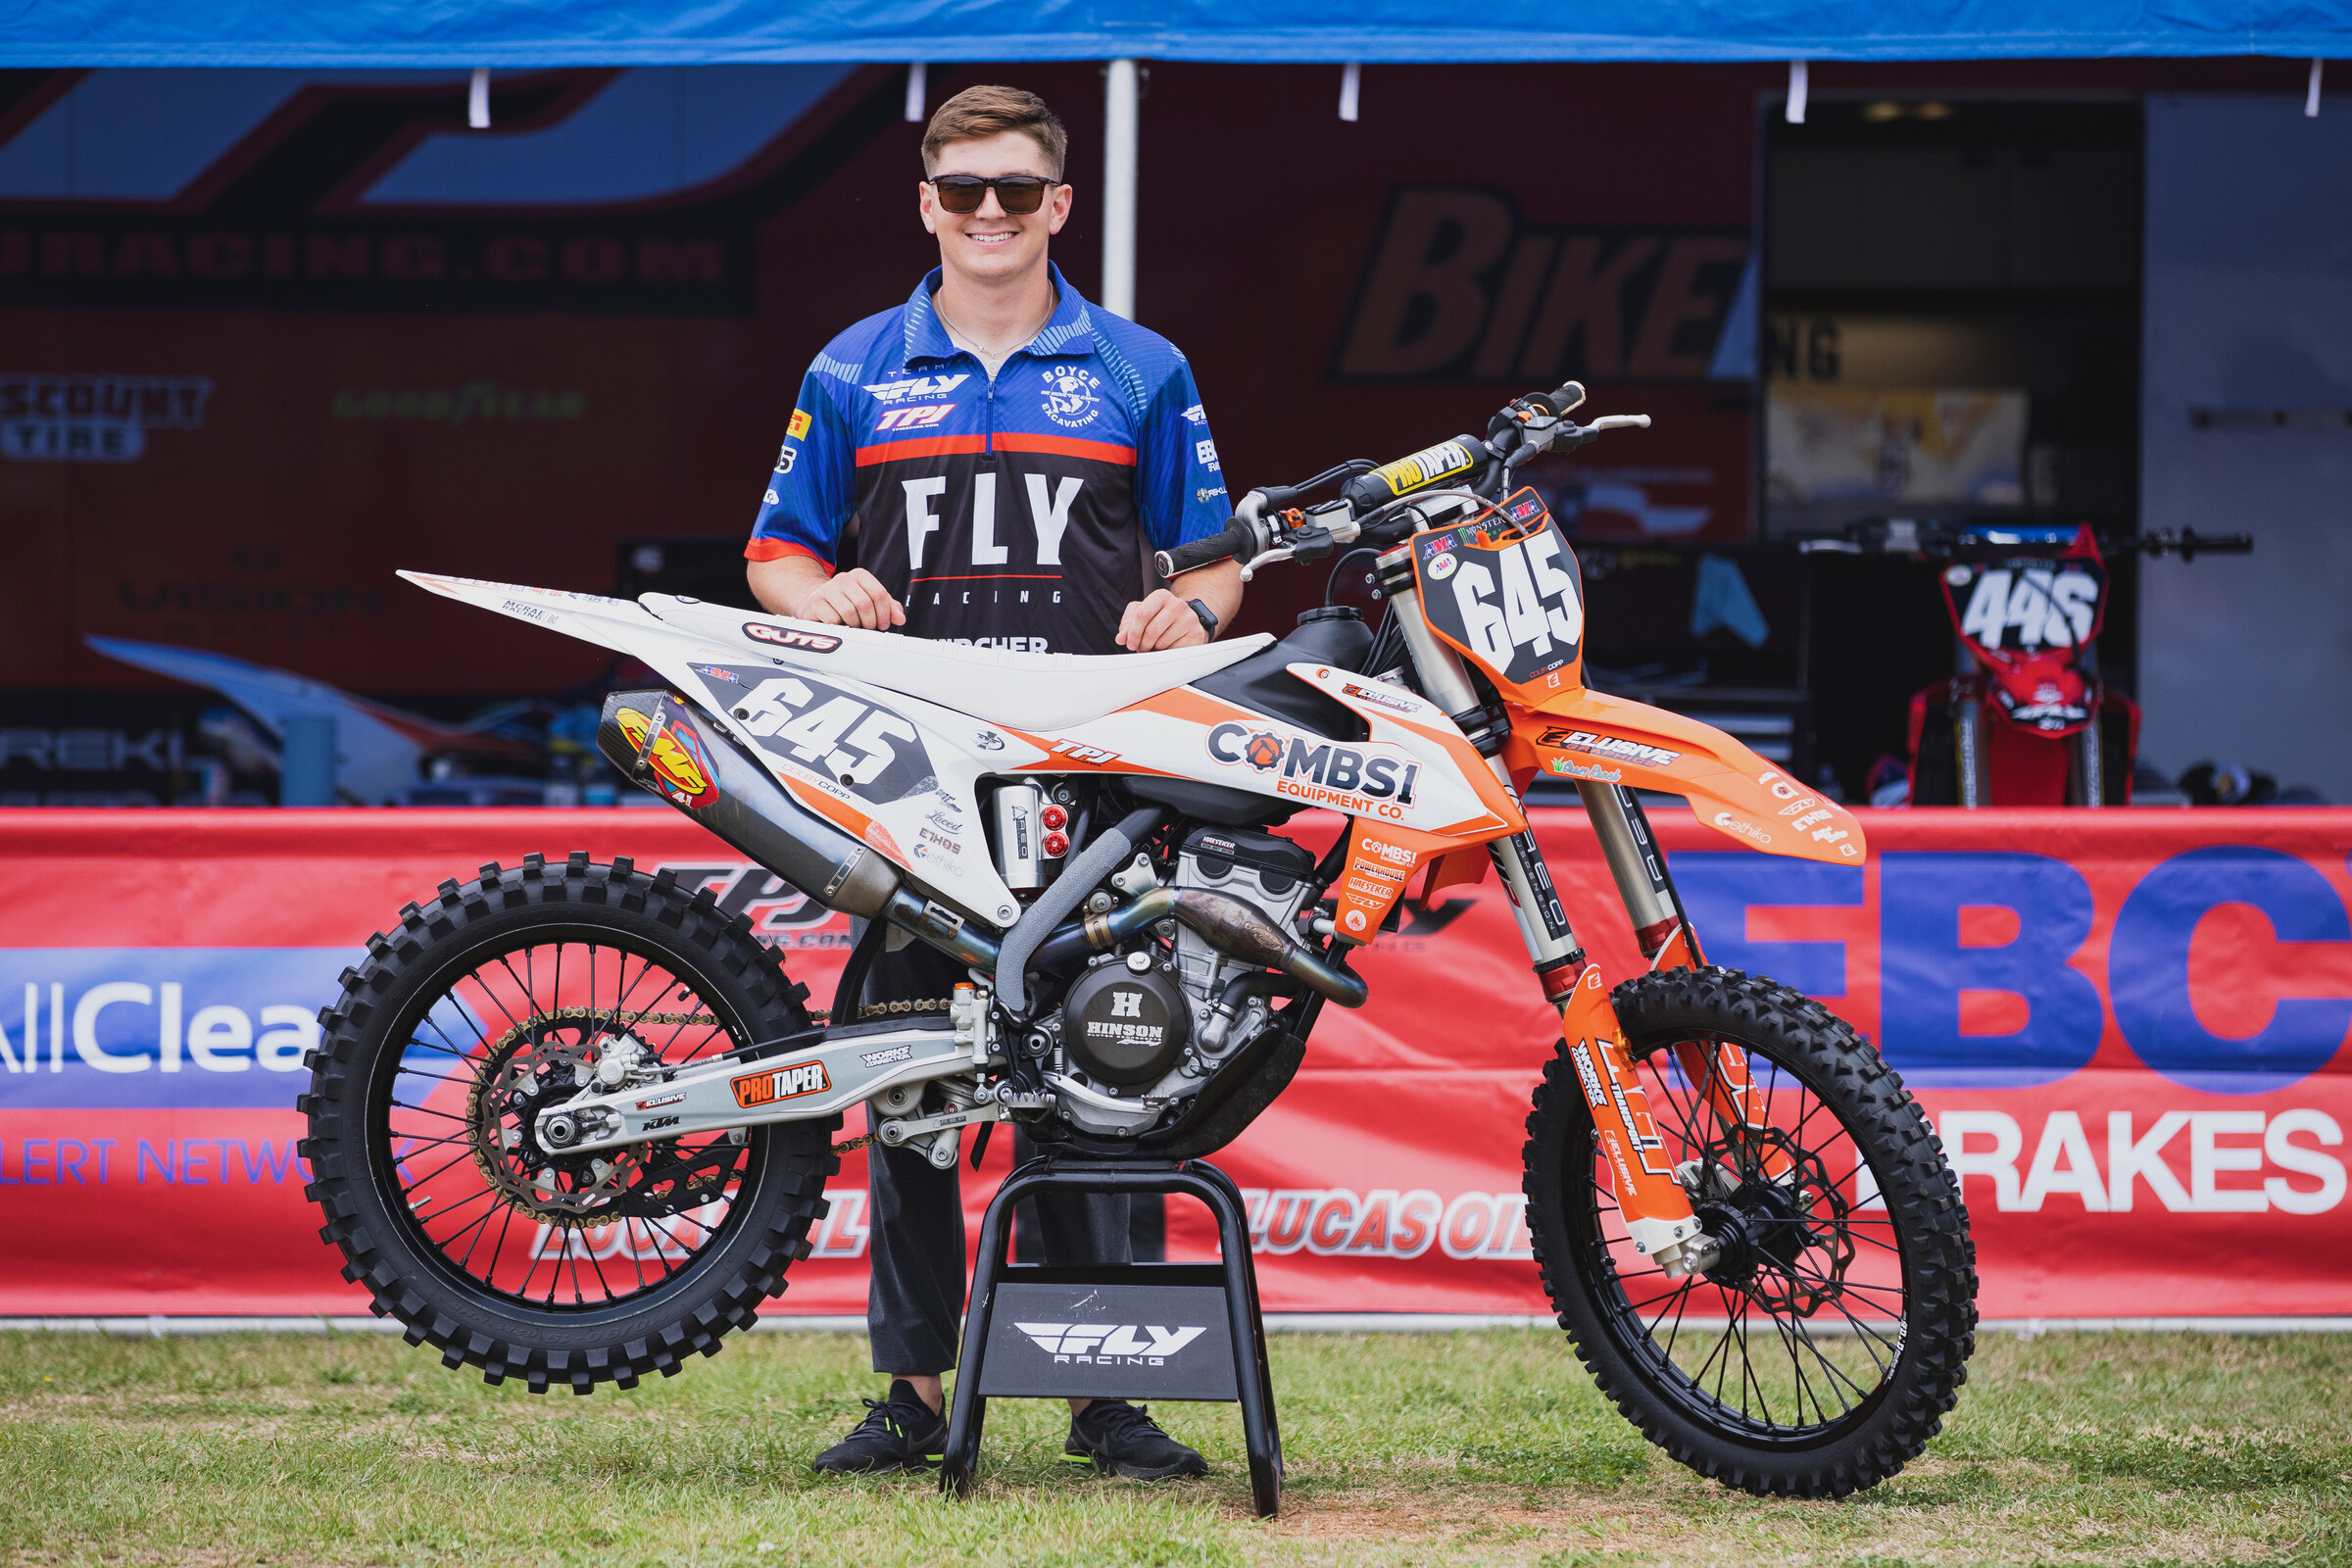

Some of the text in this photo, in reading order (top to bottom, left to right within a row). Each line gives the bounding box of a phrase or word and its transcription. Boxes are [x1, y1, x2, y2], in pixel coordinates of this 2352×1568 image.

[888, 364, 945, 377] TEAM
[1042, 366, 1101, 389] BOYCE
[862, 374, 970, 400] FLY
[883, 393, 948, 406] RACING
[1042, 403, 1099, 427] EXCAVATING
[1197, 440, 1218, 465] EB
[901, 472, 1085, 570] FLY
[1510, 498, 1540, 519] AMA
[1466, 515, 1506, 536] MONSTER
[1423, 534, 1457, 560] AMA
[1436, 558, 1452, 572] AMA
[1452, 529, 1583, 674] 645
[746, 623, 839, 650] GUTS
[696, 665, 740, 684] AMA
[728, 677, 917, 784] 645
[1562, 731, 1682, 765] ELUSIVE
[1565, 743, 1658, 768] GRAPHICS
[1277, 781, 1404, 820] EQUIPMENT CO.
[926, 807, 962, 835] Laced
[1730, 820, 1772, 845] ethika
[1354, 858, 1405, 882] POWERHOUSE
[1514, 834, 1555, 929] USPENSION
[1348, 877, 1394, 898] HAESEKER
[1667, 845, 2352, 1097] EBC
[1111, 991, 1143, 1017] H
[0, 982, 321, 1074] llClea
[1087, 1021, 1163, 1038] HINSON
[862, 1045, 910, 1060] WORKS
[865, 1054, 912, 1067] CONNECTION
[739, 1062, 824, 1105] PROTAPER
[1571, 1046, 1596, 1109] CONNECTION
[1577, 1038, 1608, 1107] WORKS
[642, 1115, 680, 1132] KTM
[1610, 1083, 1644, 1153] TRANSPORT
[1611, 1142, 1639, 1198] ELUSIVE
[1855, 1109, 2348, 1214] RAKES
[1241, 1188, 1445, 1260] LUCAS
[1014, 1322, 1207, 1356] FLY
[1054, 1354, 1164, 1366] RACING
